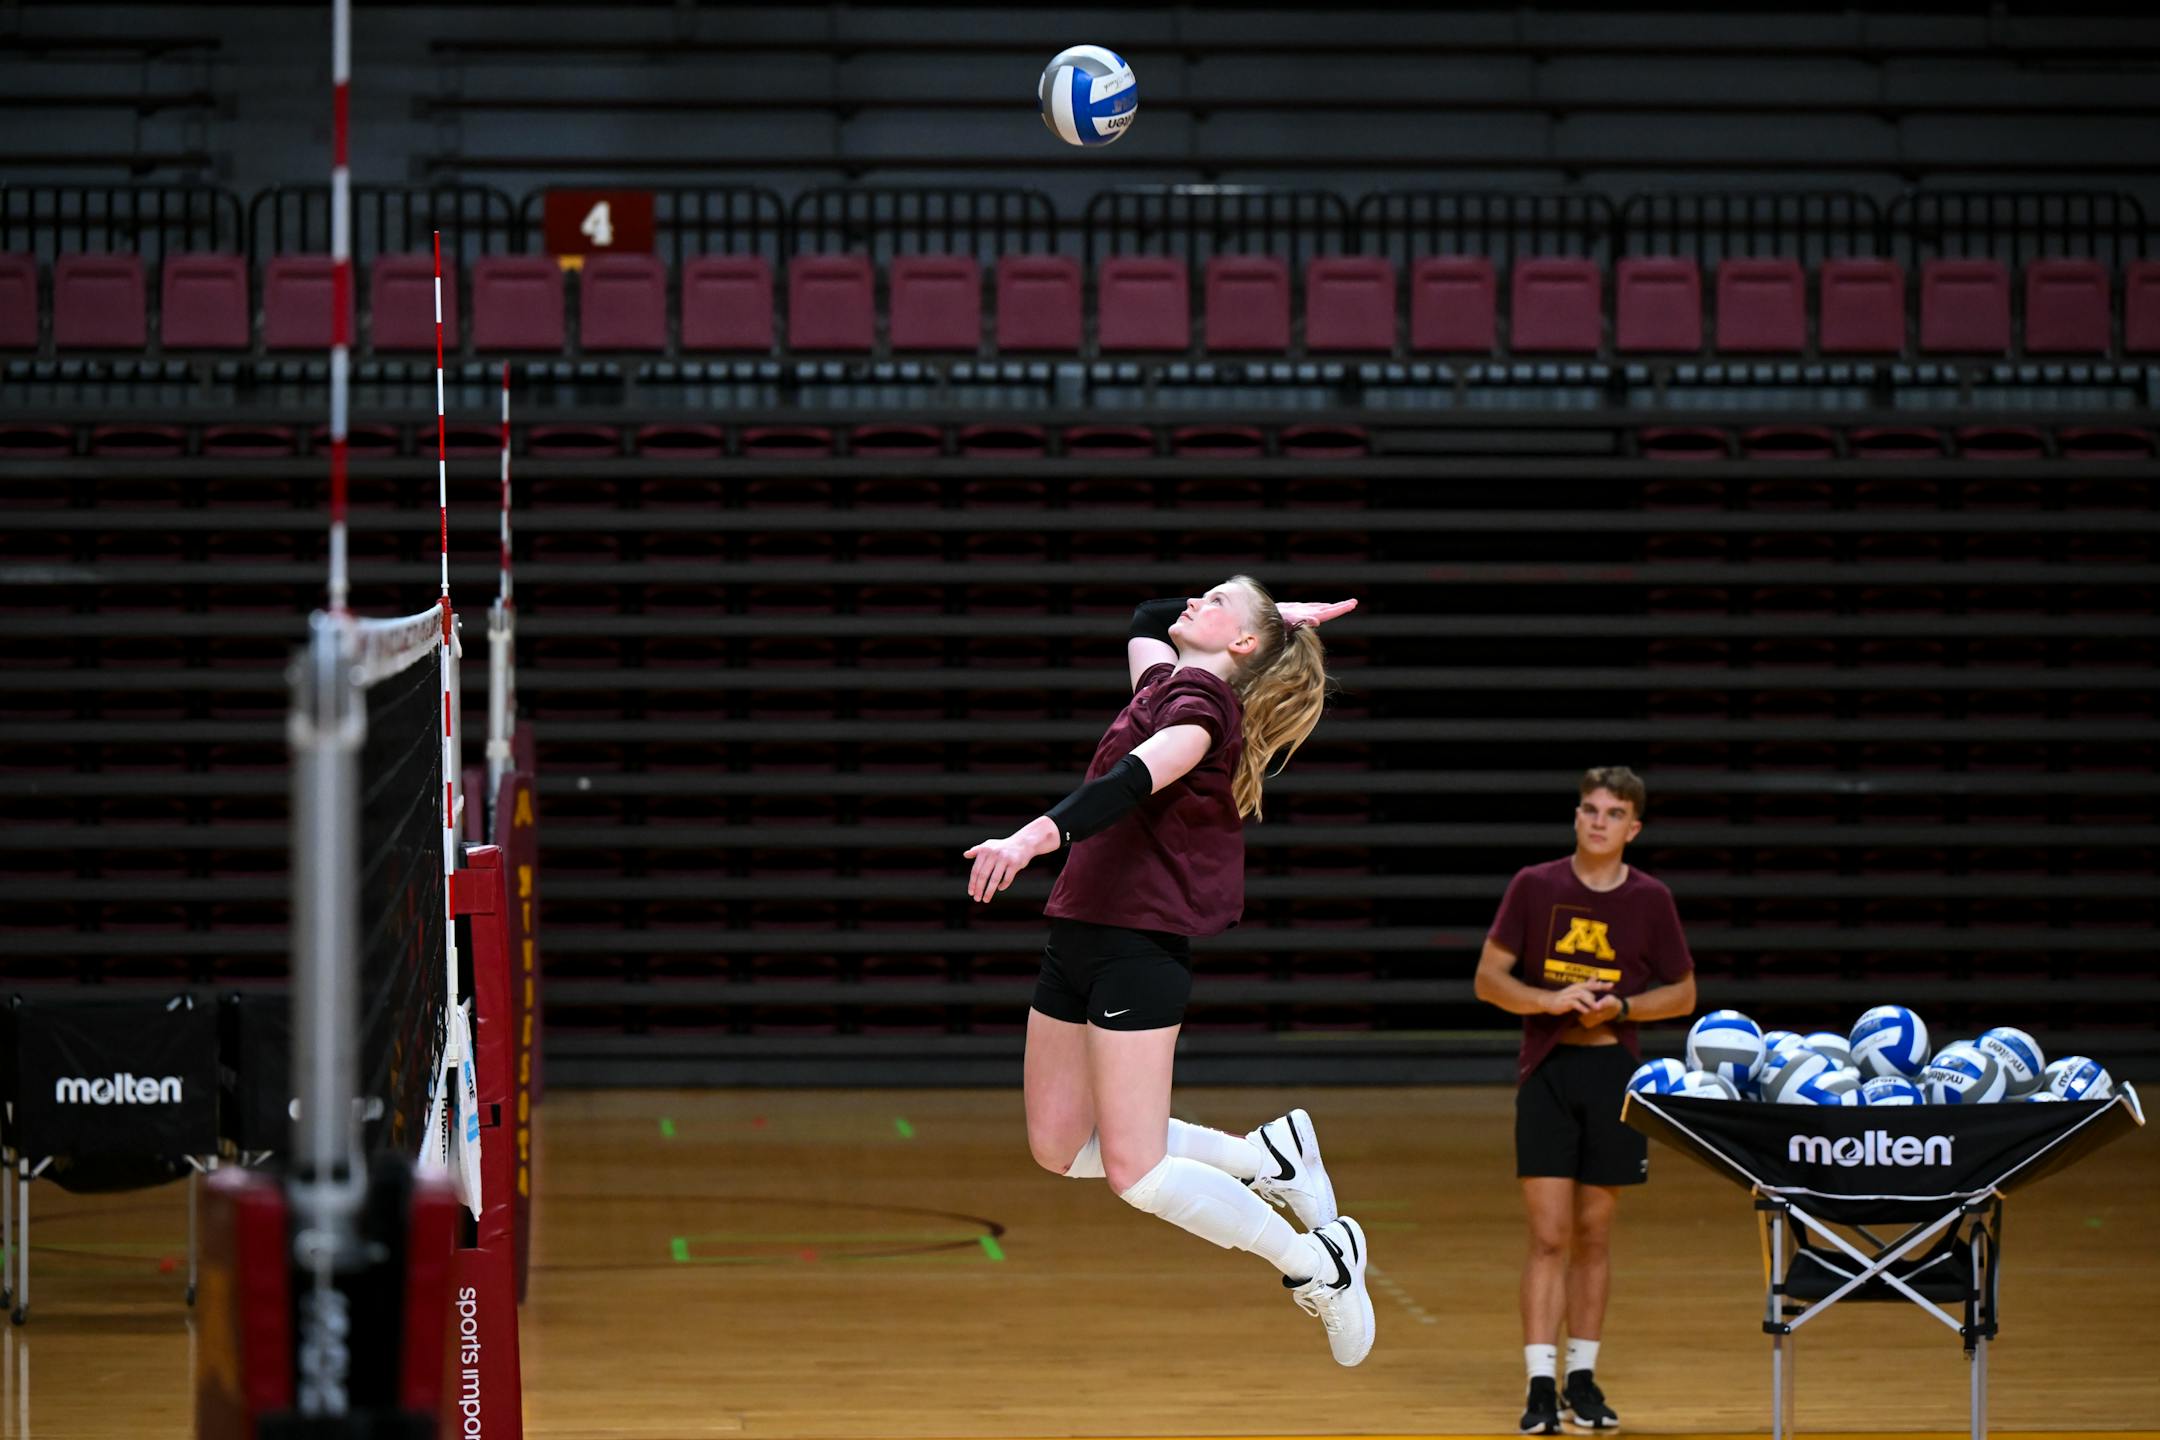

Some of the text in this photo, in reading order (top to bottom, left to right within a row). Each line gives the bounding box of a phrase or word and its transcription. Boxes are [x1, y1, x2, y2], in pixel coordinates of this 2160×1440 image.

[1107, 113, 1134, 129] lten
[581, 200, 613, 247] 4
[1555, 917, 1616, 961] M
[56, 1072, 182, 1105] molten
[1788, 1130, 1953, 1168] molten
[455, 1286, 482, 1365] sports
